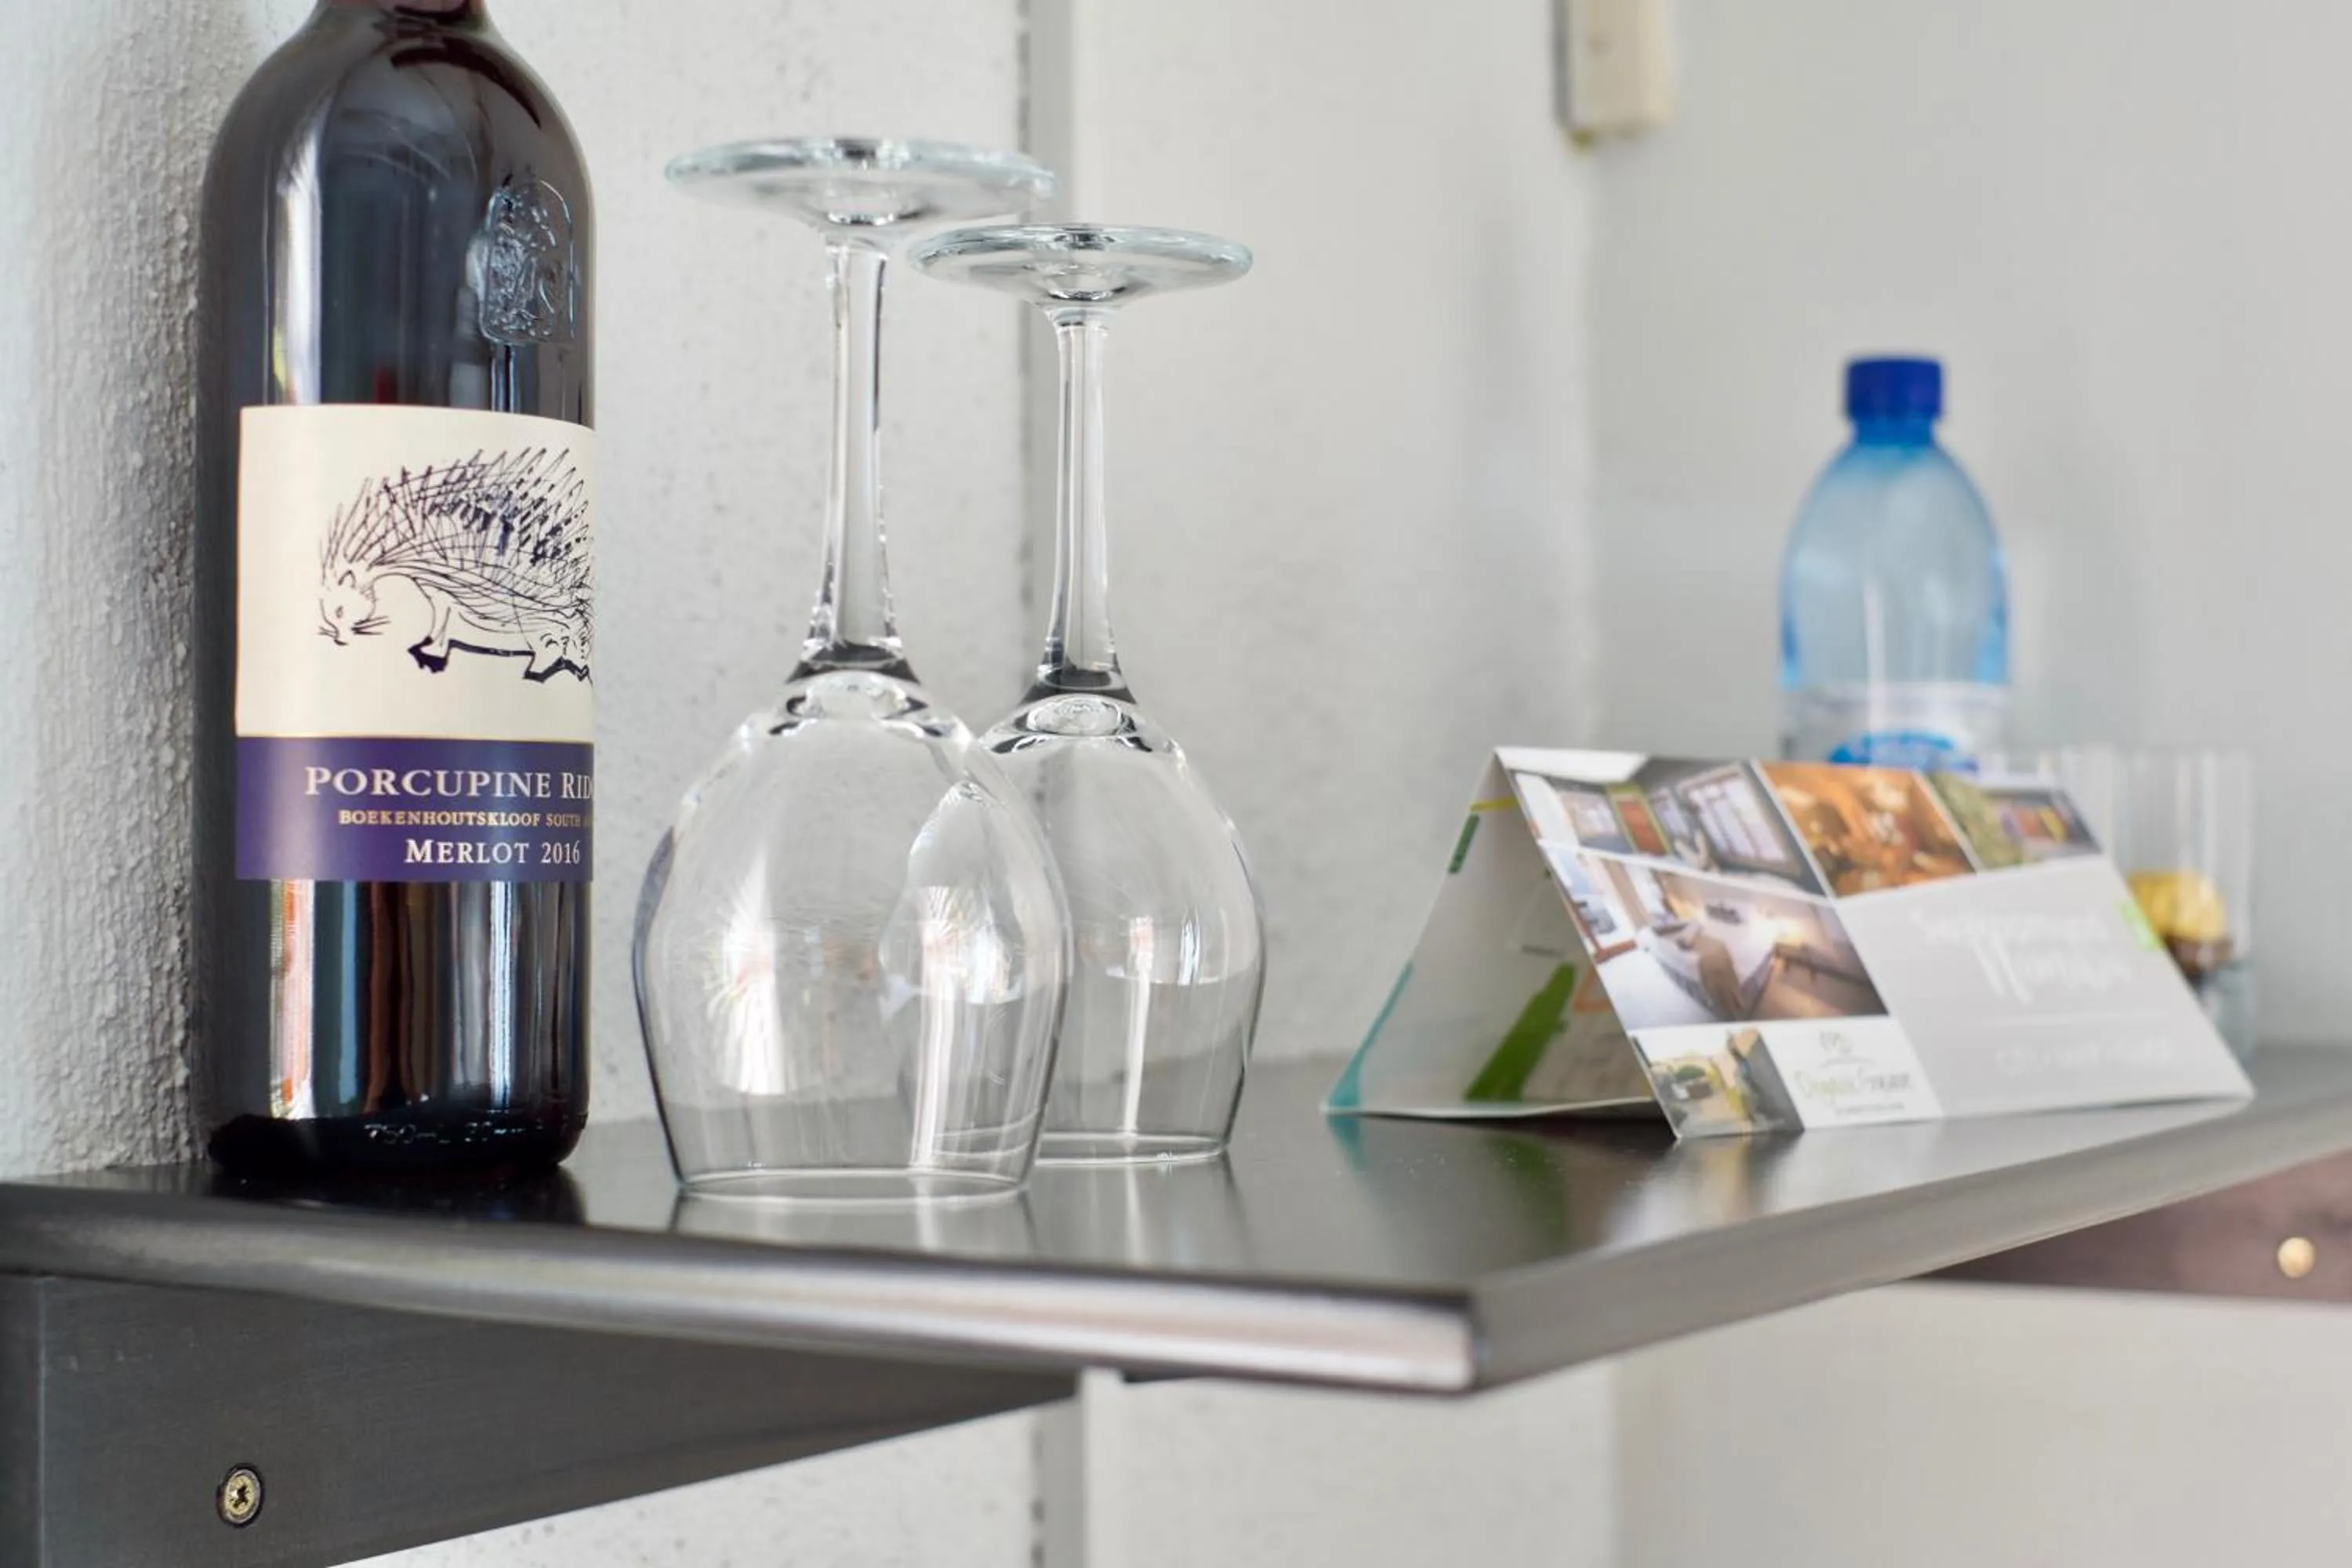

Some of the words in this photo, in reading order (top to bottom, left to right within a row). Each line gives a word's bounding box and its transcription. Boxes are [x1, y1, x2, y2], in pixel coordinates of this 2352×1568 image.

[304, 766, 551, 798] PORCUPINE
[338, 809, 541, 826] BOEKENHOUTSKLOOF
[546, 813, 581, 827] SOUTH
[405, 838, 530, 863] MERLOT
[540, 840, 580, 864] 2016
